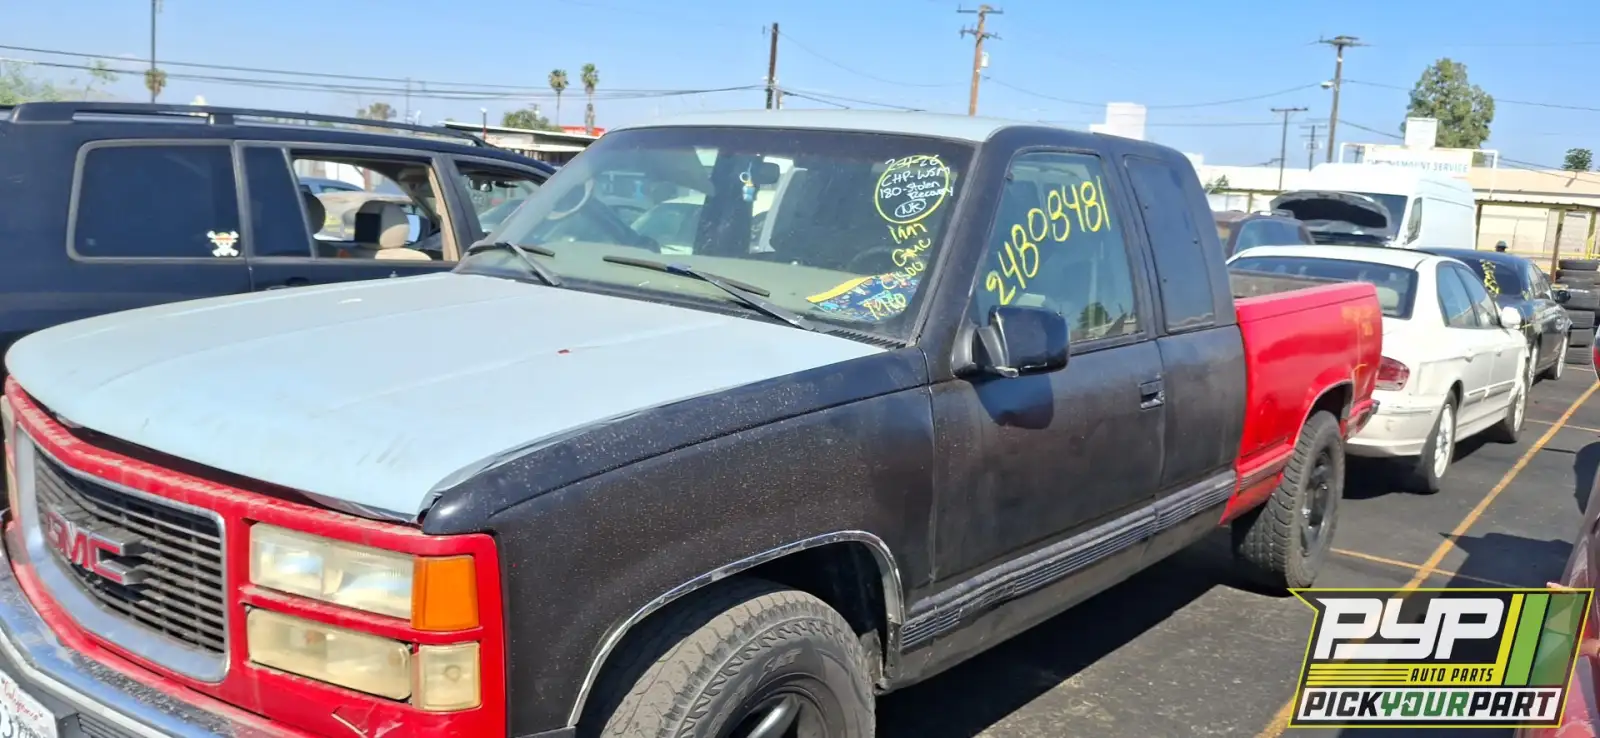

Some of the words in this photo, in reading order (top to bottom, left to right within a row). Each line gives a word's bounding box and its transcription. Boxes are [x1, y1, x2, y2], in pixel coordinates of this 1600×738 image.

[1433, 162, 1468, 173] SERVICE
[986, 175, 1111, 306] 24808481
[47, 510, 126, 586] GMC
